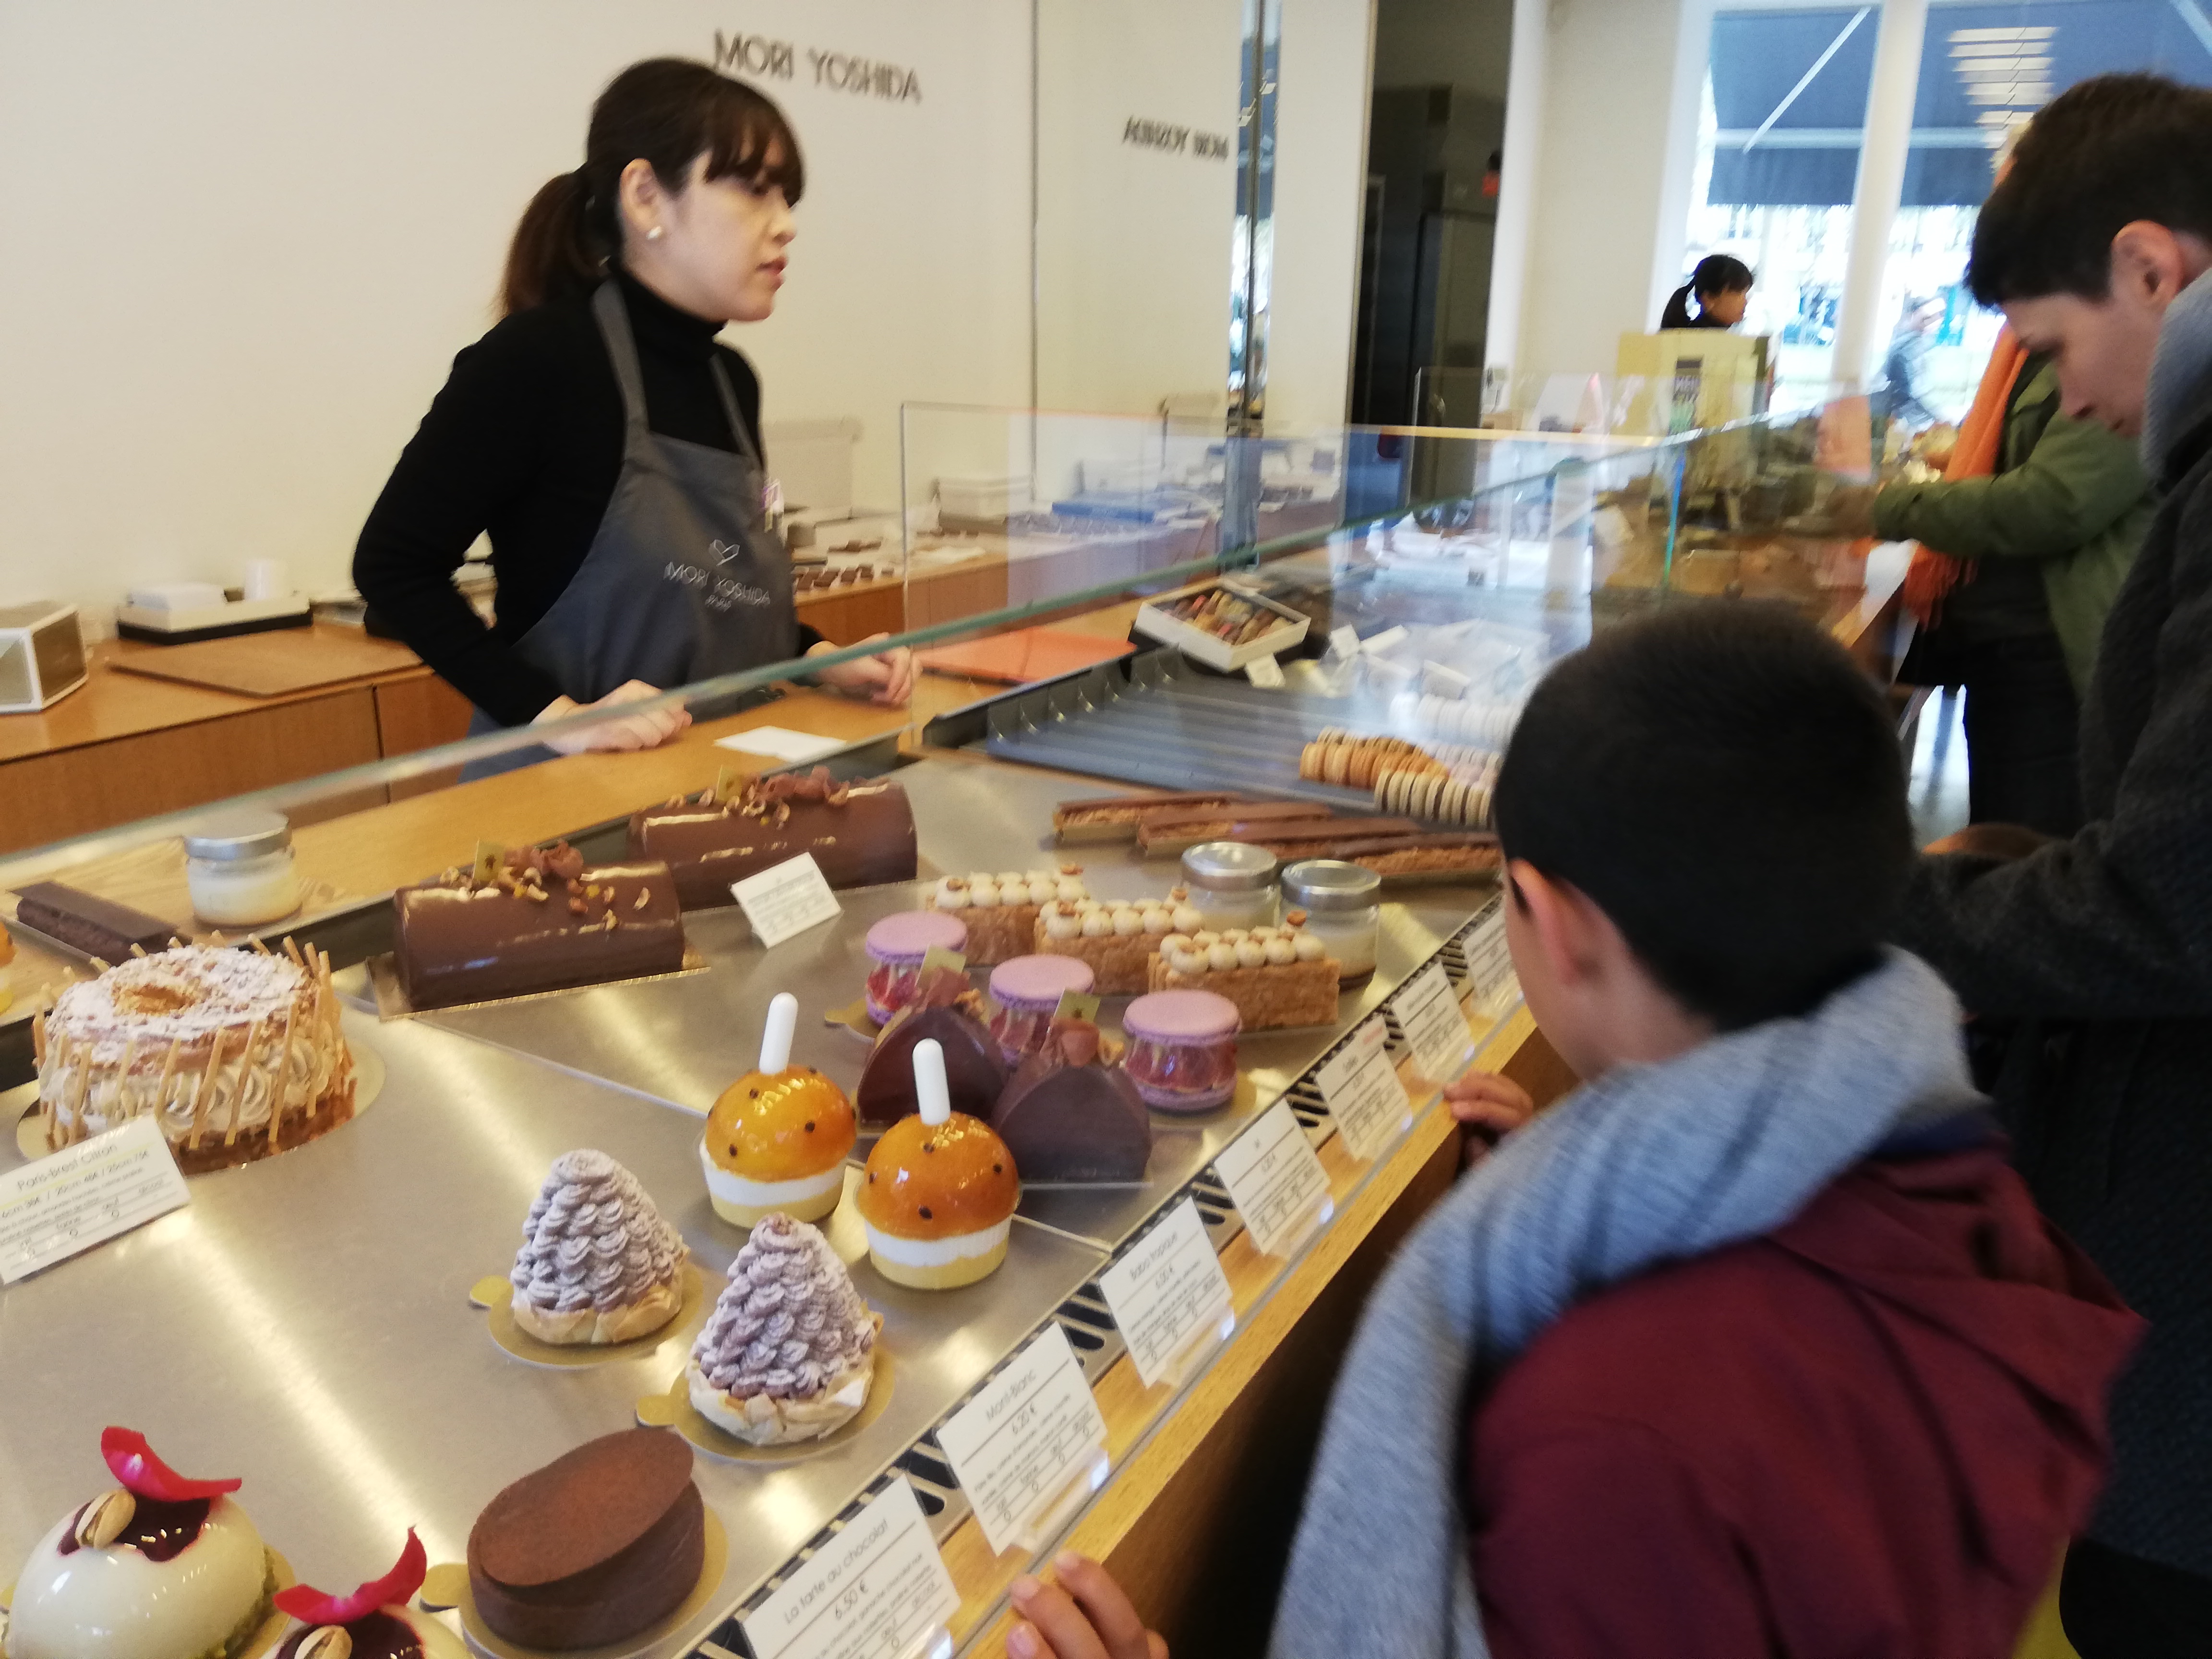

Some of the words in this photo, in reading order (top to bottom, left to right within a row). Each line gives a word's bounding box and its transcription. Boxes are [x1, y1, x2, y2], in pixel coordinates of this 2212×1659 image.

[714, 28, 794, 82] MORI
[807, 46, 922, 106] YOSHIDA
[783, 1605, 799, 1624] La
[799, 1580, 826, 1608] tarte
[827, 1565, 842, 1583] au
[843, 1518, 888, 1567] chocolat
[833, 1588, 859, 1621] 6.50
